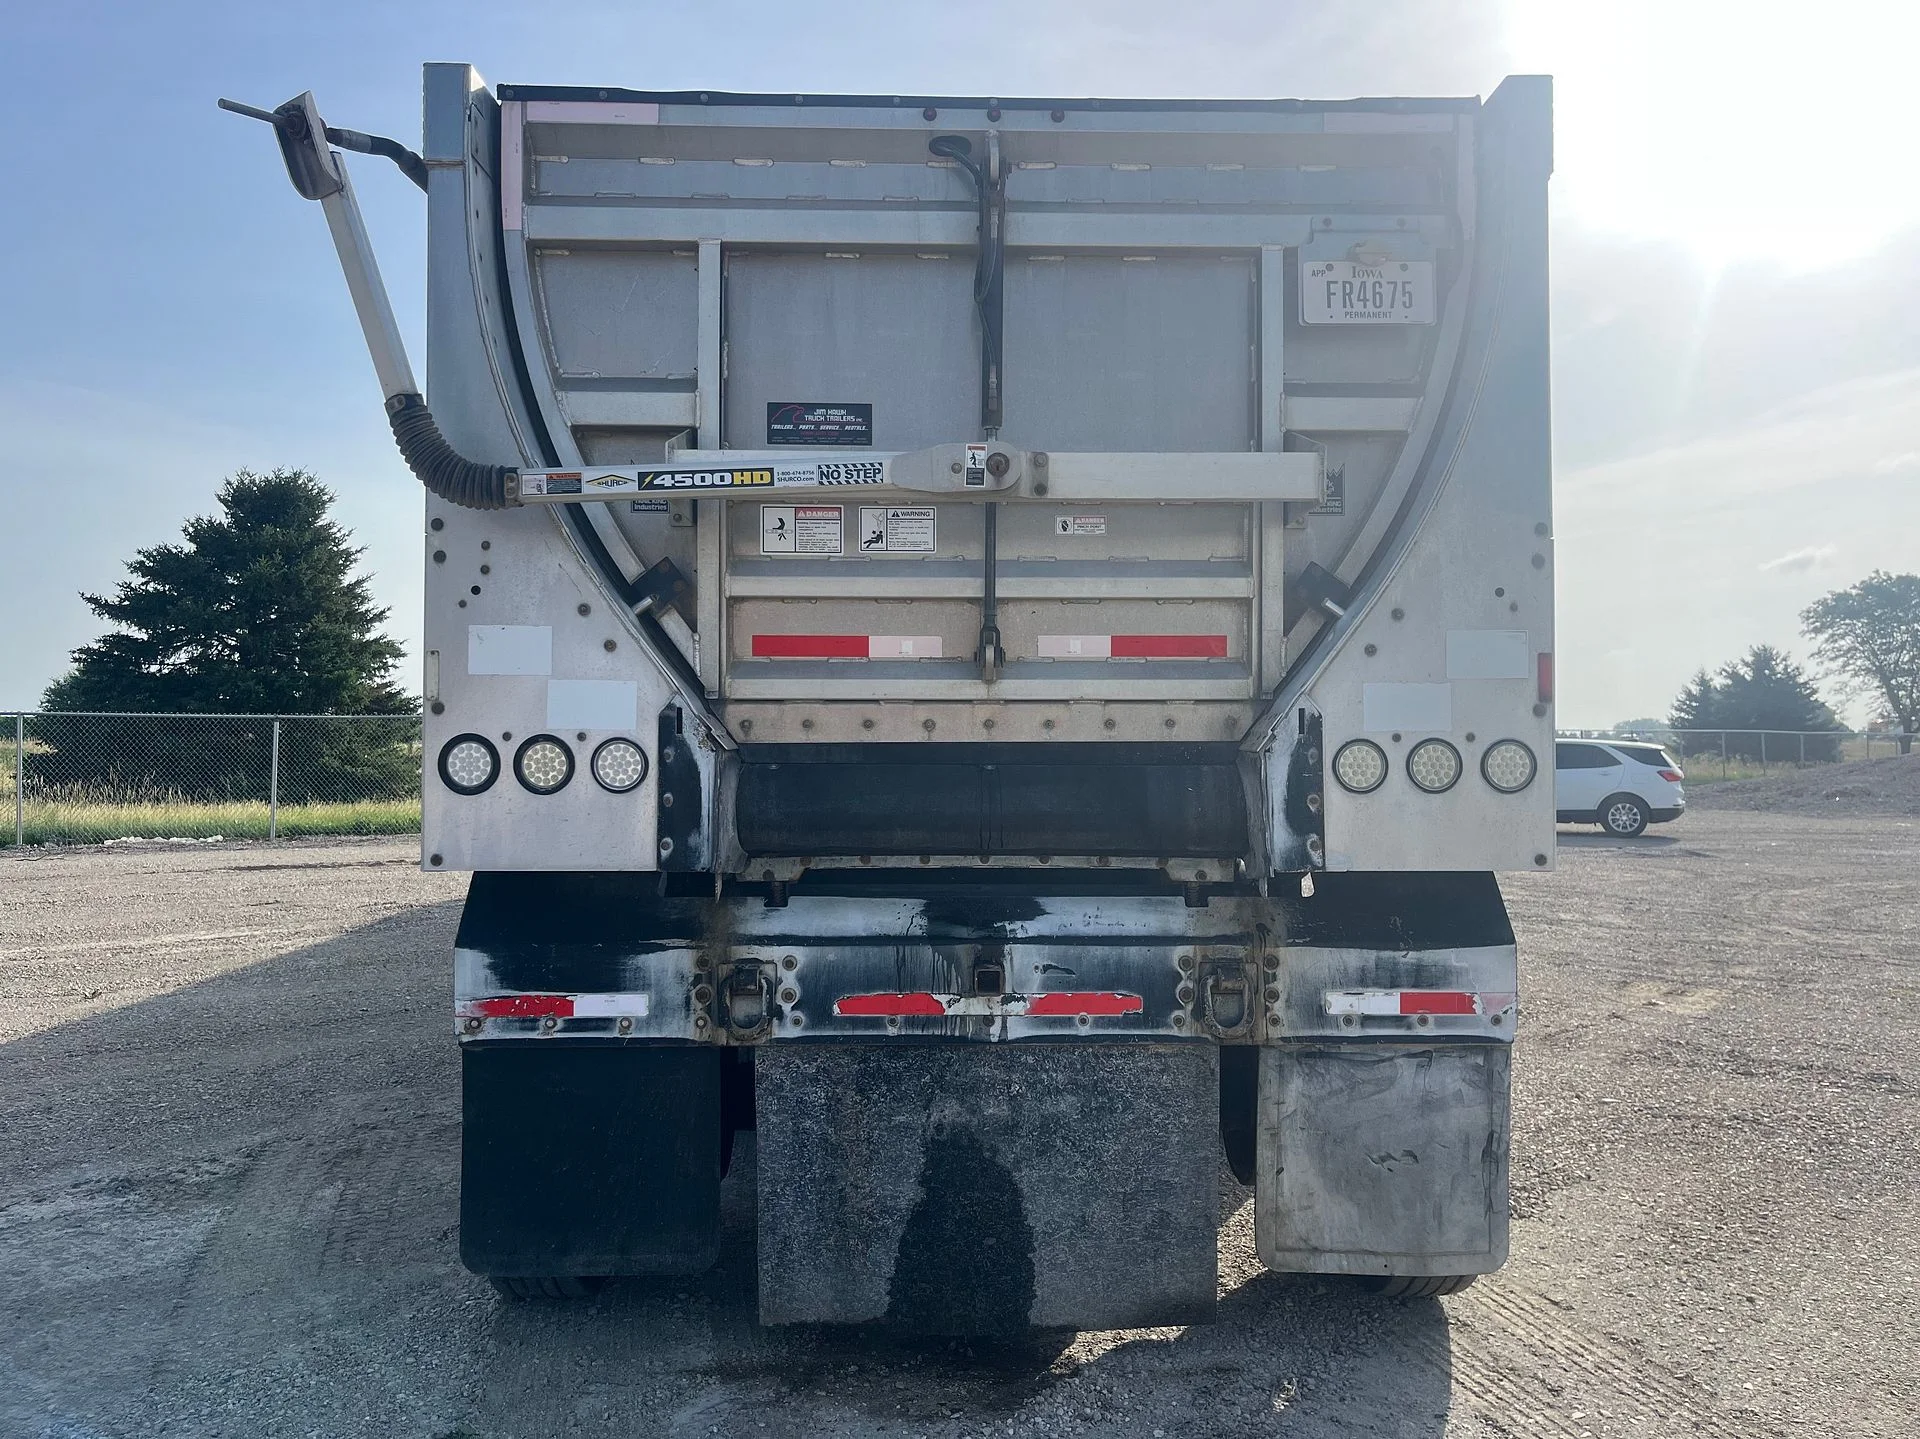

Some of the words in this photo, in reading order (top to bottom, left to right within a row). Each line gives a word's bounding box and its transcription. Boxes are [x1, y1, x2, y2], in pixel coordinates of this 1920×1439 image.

[1311, 269, 1326, 277] APP
[1326, 280, 1413, 309] FR4675
[1344, 311, 1392, 319] PERMANENT
[654, 471, 771, 487] 4500HD
[819, 469, 841, 480] NO
[844, 467, 882, 479] STEP
